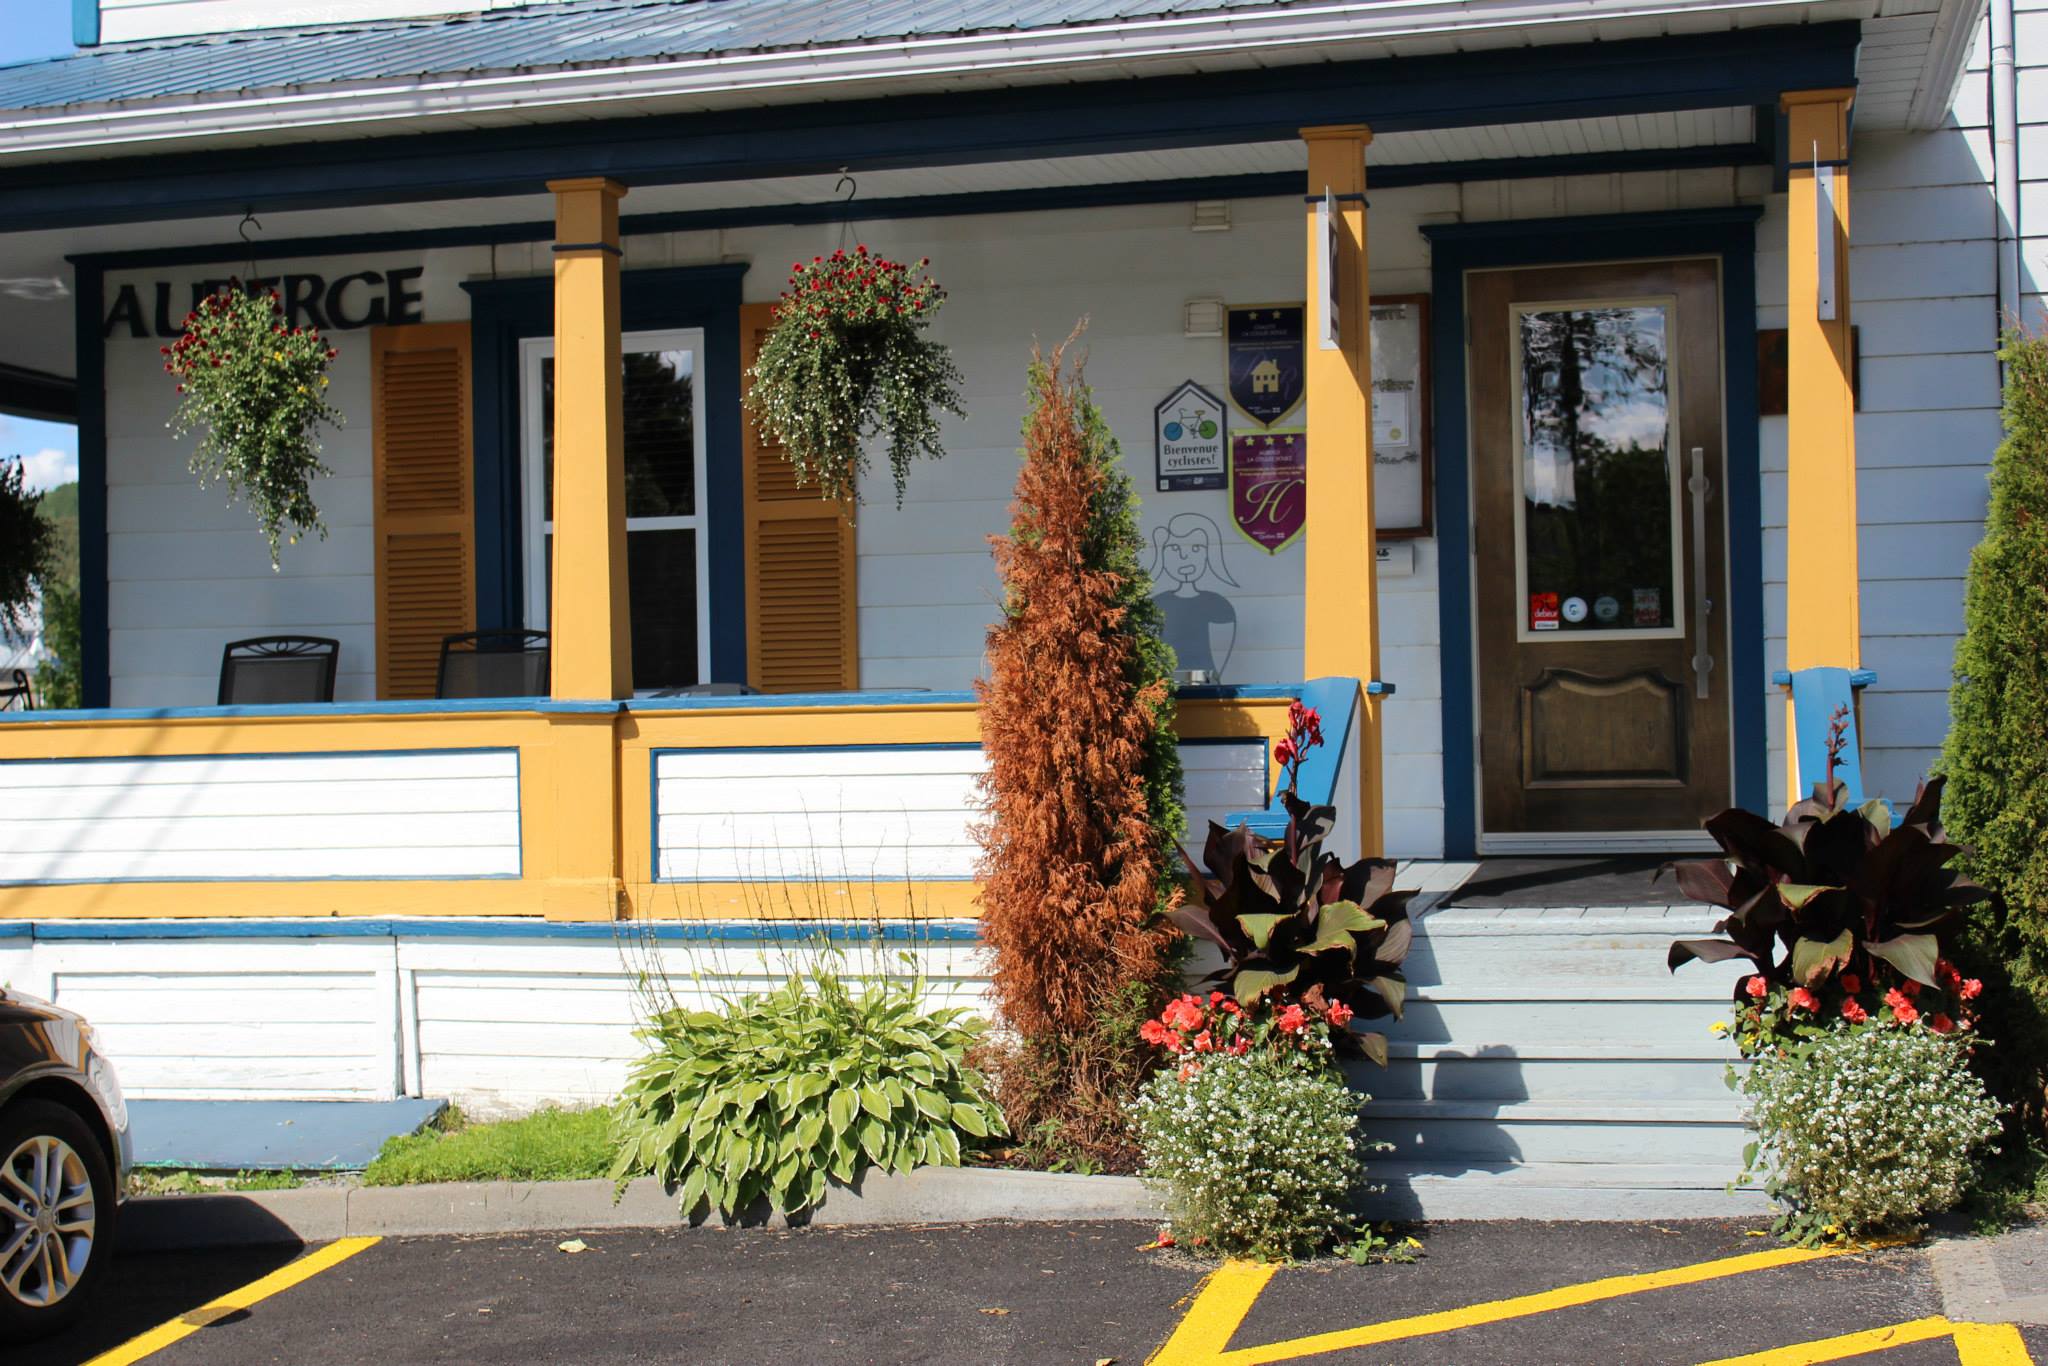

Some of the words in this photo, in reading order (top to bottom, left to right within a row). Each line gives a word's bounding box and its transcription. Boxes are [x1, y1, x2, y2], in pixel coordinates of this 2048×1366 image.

[1163, 444, 1219, 455] Bienvenue
[1167, 454, 1216, 467] cyclistes!
[1239, 479, 1305, 524] H
